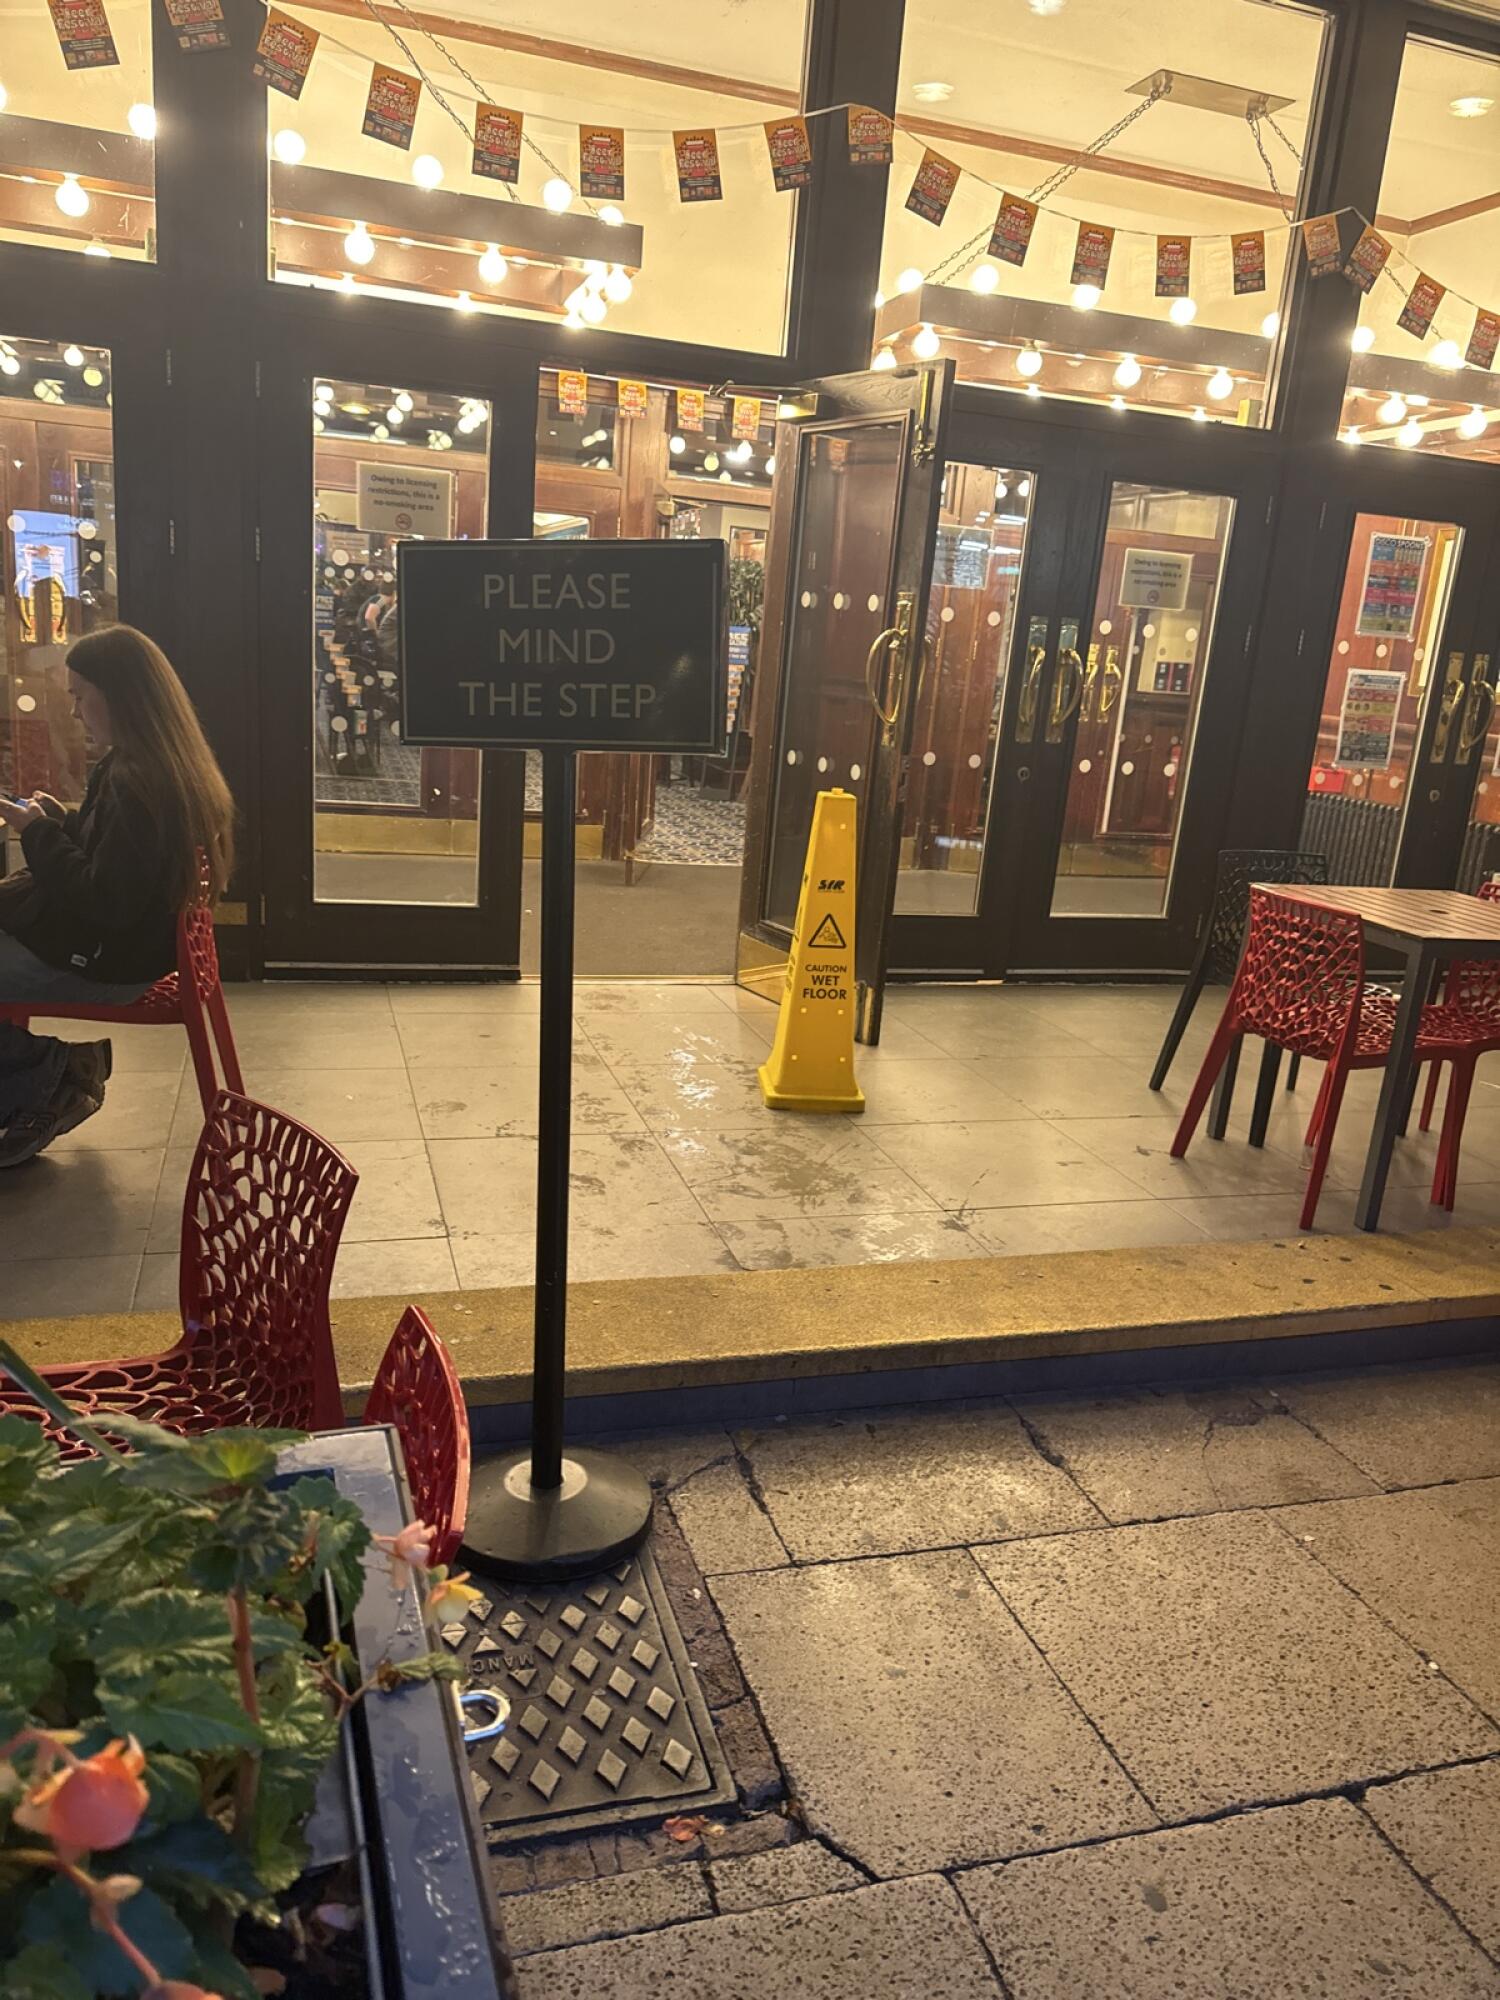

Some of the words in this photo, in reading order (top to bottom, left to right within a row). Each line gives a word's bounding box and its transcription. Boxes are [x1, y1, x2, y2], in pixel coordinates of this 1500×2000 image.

[64, 8, 92, 17] Beer
[57, 15, 105, 30] Festival
[263, 34, 309, 65] Festival
[278, 33, 300, 53] Beer
[370, 90, 415, 115] Festival
[382, 86, 408, 106] Beer
[486, 123, 511, 138] Beer
[477, 128, 519, 149] Festival
[777, 137, 799, 148] Beer
[590, 146, 613, 156] Beer
[685, 149, 709, 160] Beer
[582, 152, 622, 166] Festival
[678, 157, 716, 168] Festival
[370, 474, 395, 485] Owing
[483, 573, 631, 609] PLEASE
[499, 628, 616, 664] MIND
[458, 681, 543, 717] THE
[558, 682, 657, 719] STEP
[818, 879, 846, 890] SIR
[805, 964, 847, 973] CAUTION
[811, 974, 840, 986] WET
[802, 988, 847, 1000] FLOOR
